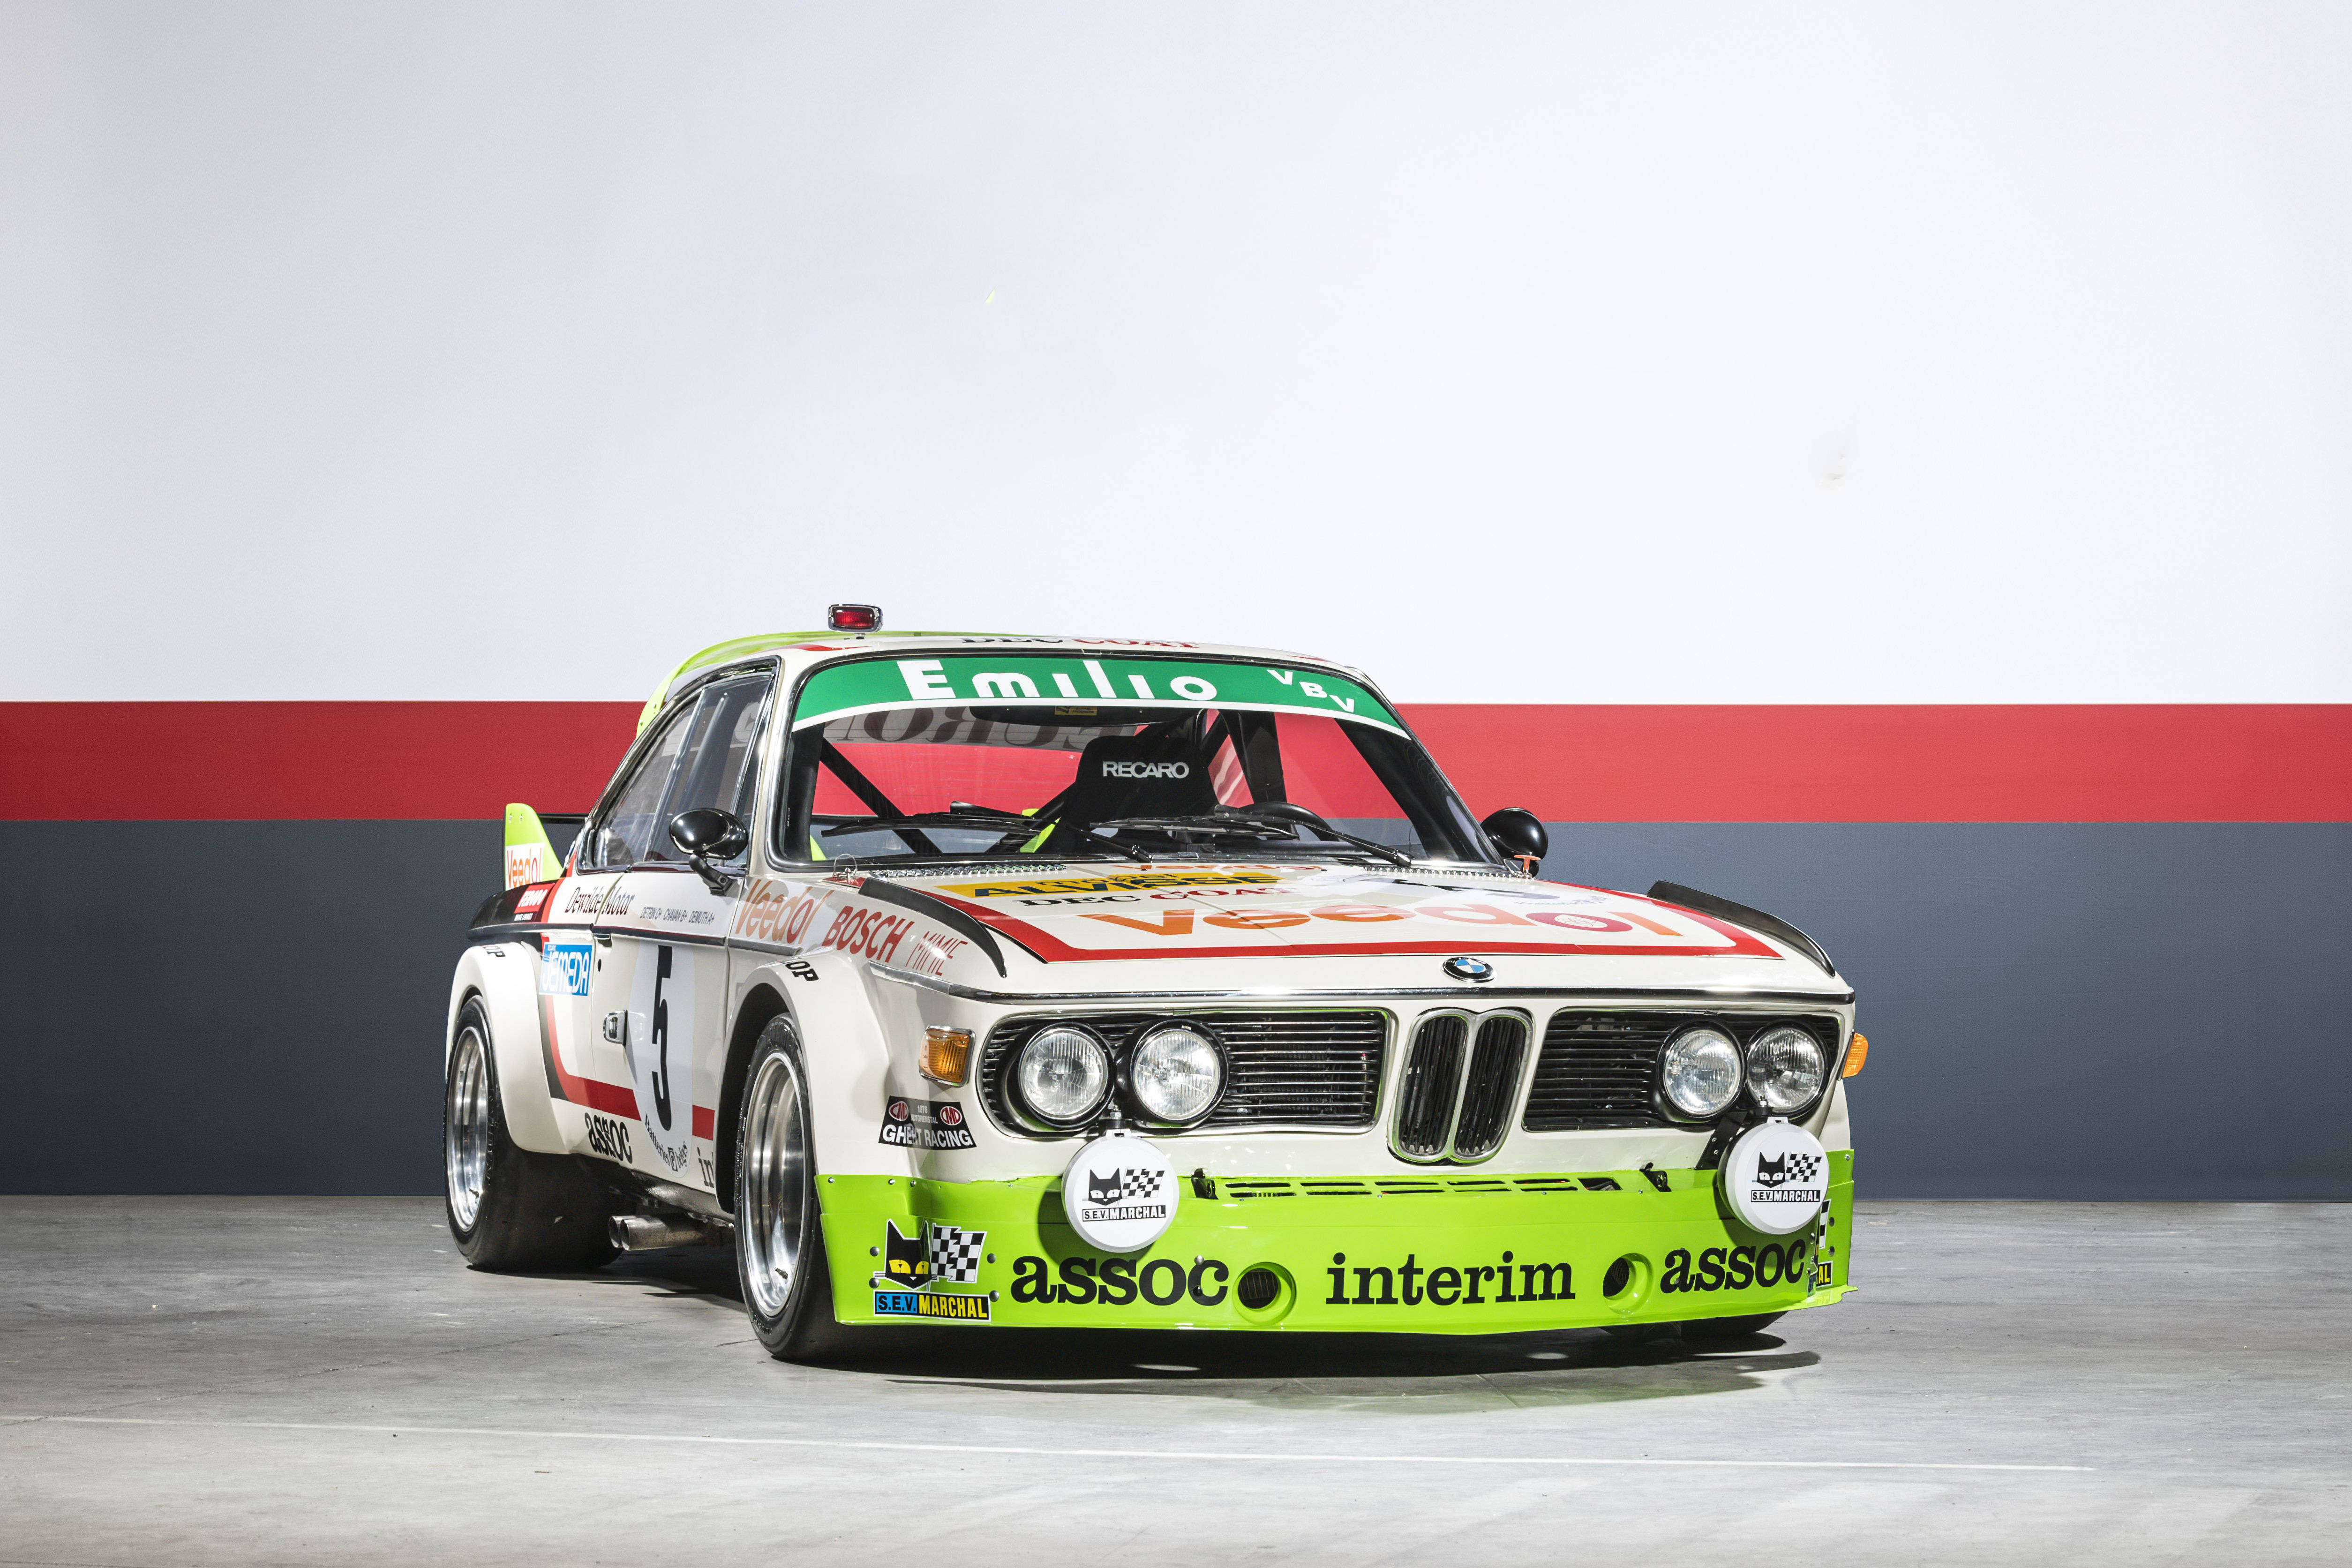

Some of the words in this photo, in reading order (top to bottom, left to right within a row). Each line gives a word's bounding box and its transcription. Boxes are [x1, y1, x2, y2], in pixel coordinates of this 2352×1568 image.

[896, 660, 1217, 700] Emilio
[1103, 761, 1189, 779] RECARO
[975, 876, 1279, 897] ALVISSE
[1014, 896, 1141, 906] DEC
[1150, 887, 1301, 900] COAT
[601, 886, 635, 915] Motor
[822, 906, 915, 962] BOSCH
[652, 945, 673, 1131] 5
[917, 1104, 928, 1113] 1976
[585, 1112, 632, 1164] assoc
[882, 1124, 922, 1146] GHENT
[924, 1129, 973, 1147] RACING
[1752, 1192, 1773, 1200] S.E.V.
[1773, 1190, 1819, 1201] MARCHAL
[1084, 1210, 1108, 1219] S.E.V.
[1110, 1206, 1165, 1220] MARCHAL
[1326, 1250, 1576, 1305] interim
[1660, 1239, 1805, 1294] assoc
[1010, 1255, 1229, 1306] assoc
[878, 1295, 916, 1312] S.E.V.
[919, 1294, 988, 1318] MARCHAL
